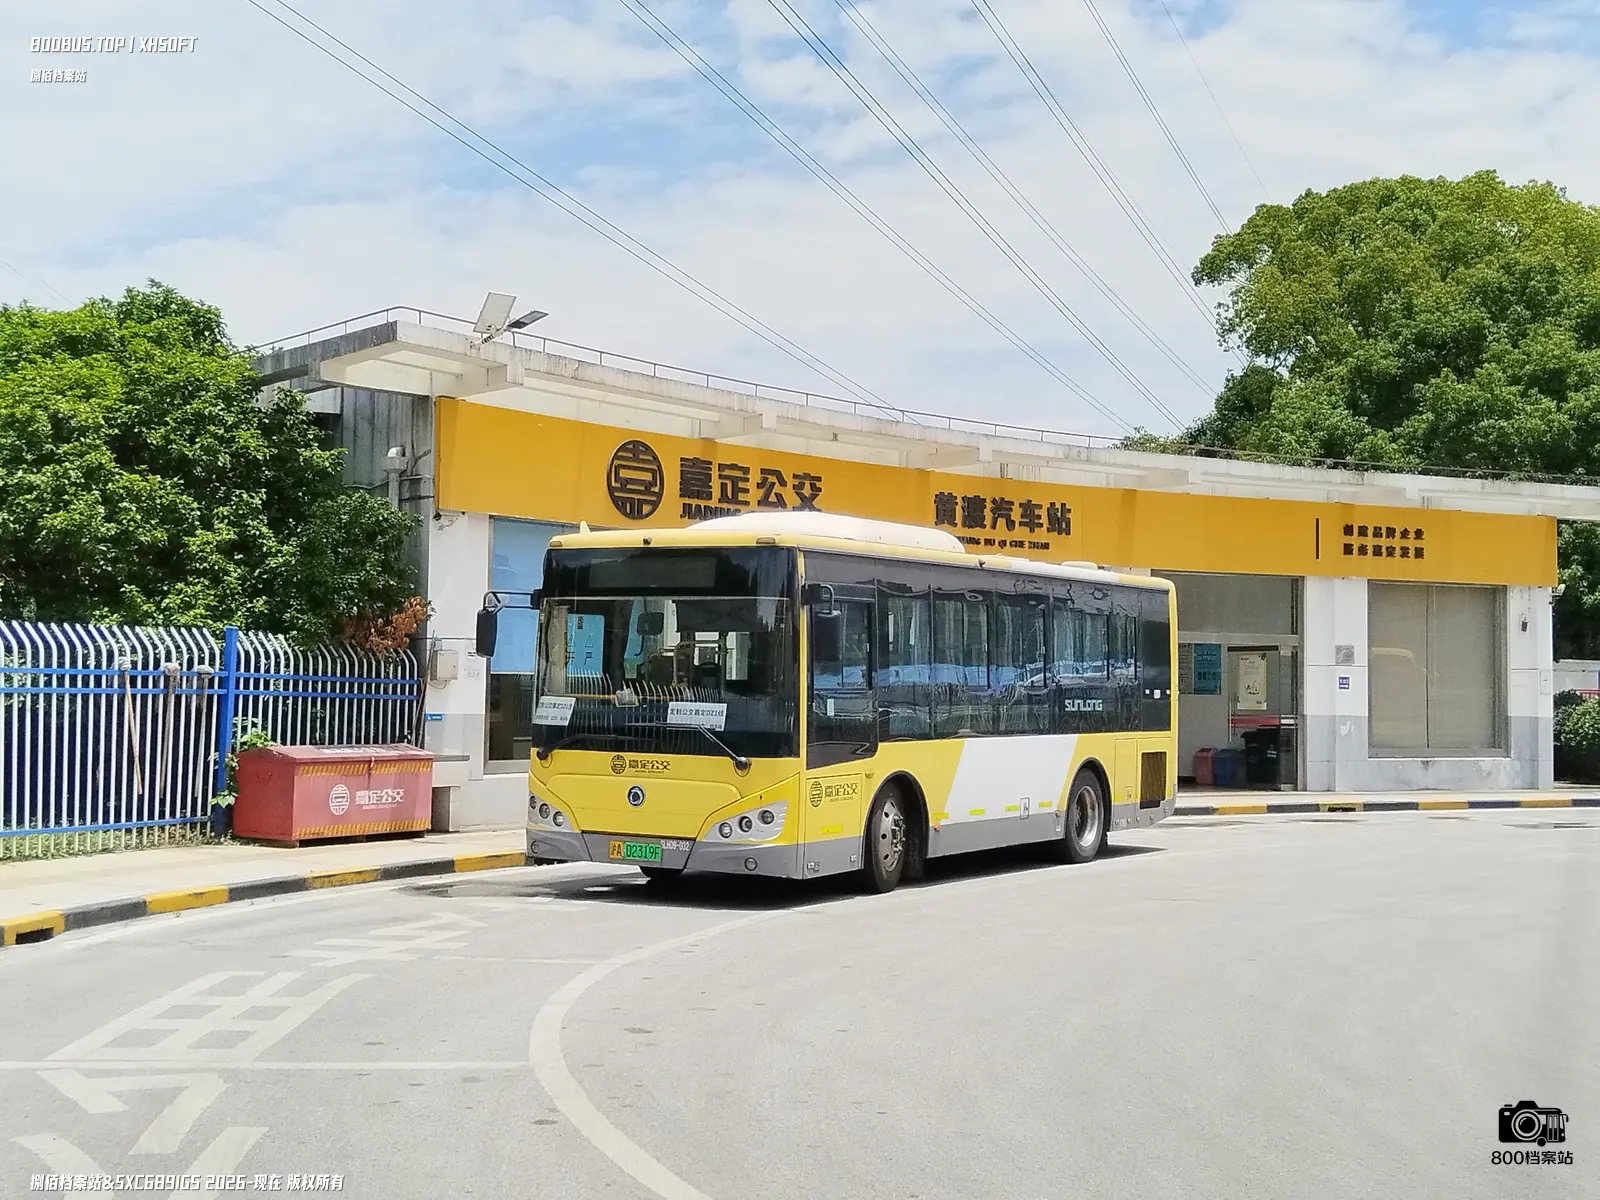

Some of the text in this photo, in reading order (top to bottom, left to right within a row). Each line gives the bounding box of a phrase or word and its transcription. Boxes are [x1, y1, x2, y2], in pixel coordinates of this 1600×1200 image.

[679, 456, 823, 512] 嘉定公交
[934, 491, 1072, 536] 黄渡汽车站
[628, 759, 671, 771] 嘉定公交
[355, 788, 405, 804] 嘉定公交
[824, 782, 859, 798] 嘉定公交
